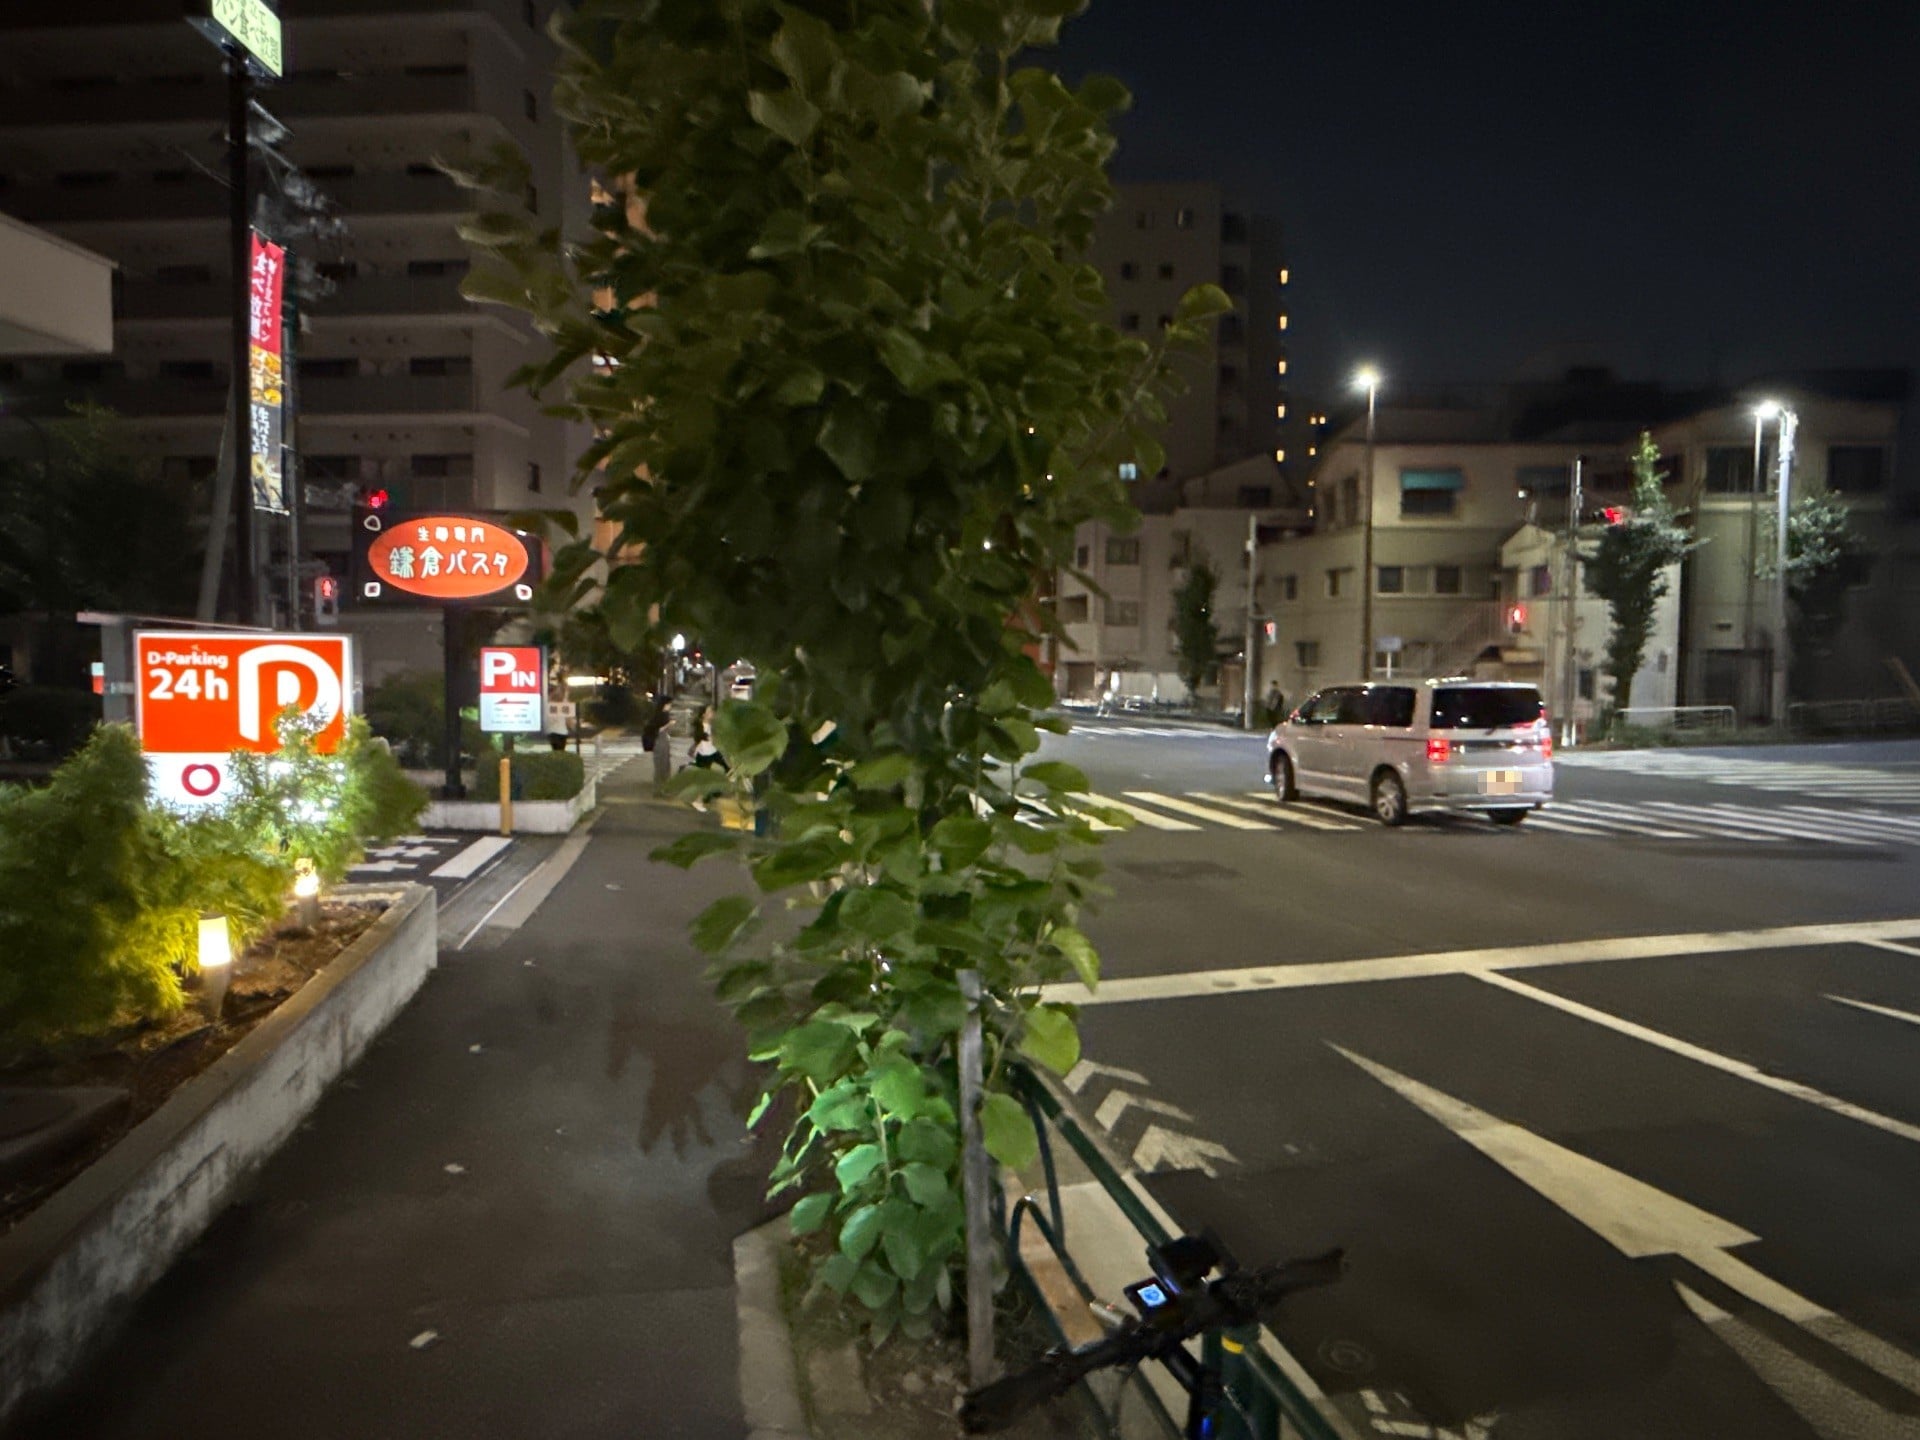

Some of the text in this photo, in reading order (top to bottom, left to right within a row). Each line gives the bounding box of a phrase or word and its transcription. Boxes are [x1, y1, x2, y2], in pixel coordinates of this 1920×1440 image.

[389, 545, 508, 579] 鎌倉パスタ
[147, 651, 229, 669] D-Parking
[148, 669, 229, 700] 24h
